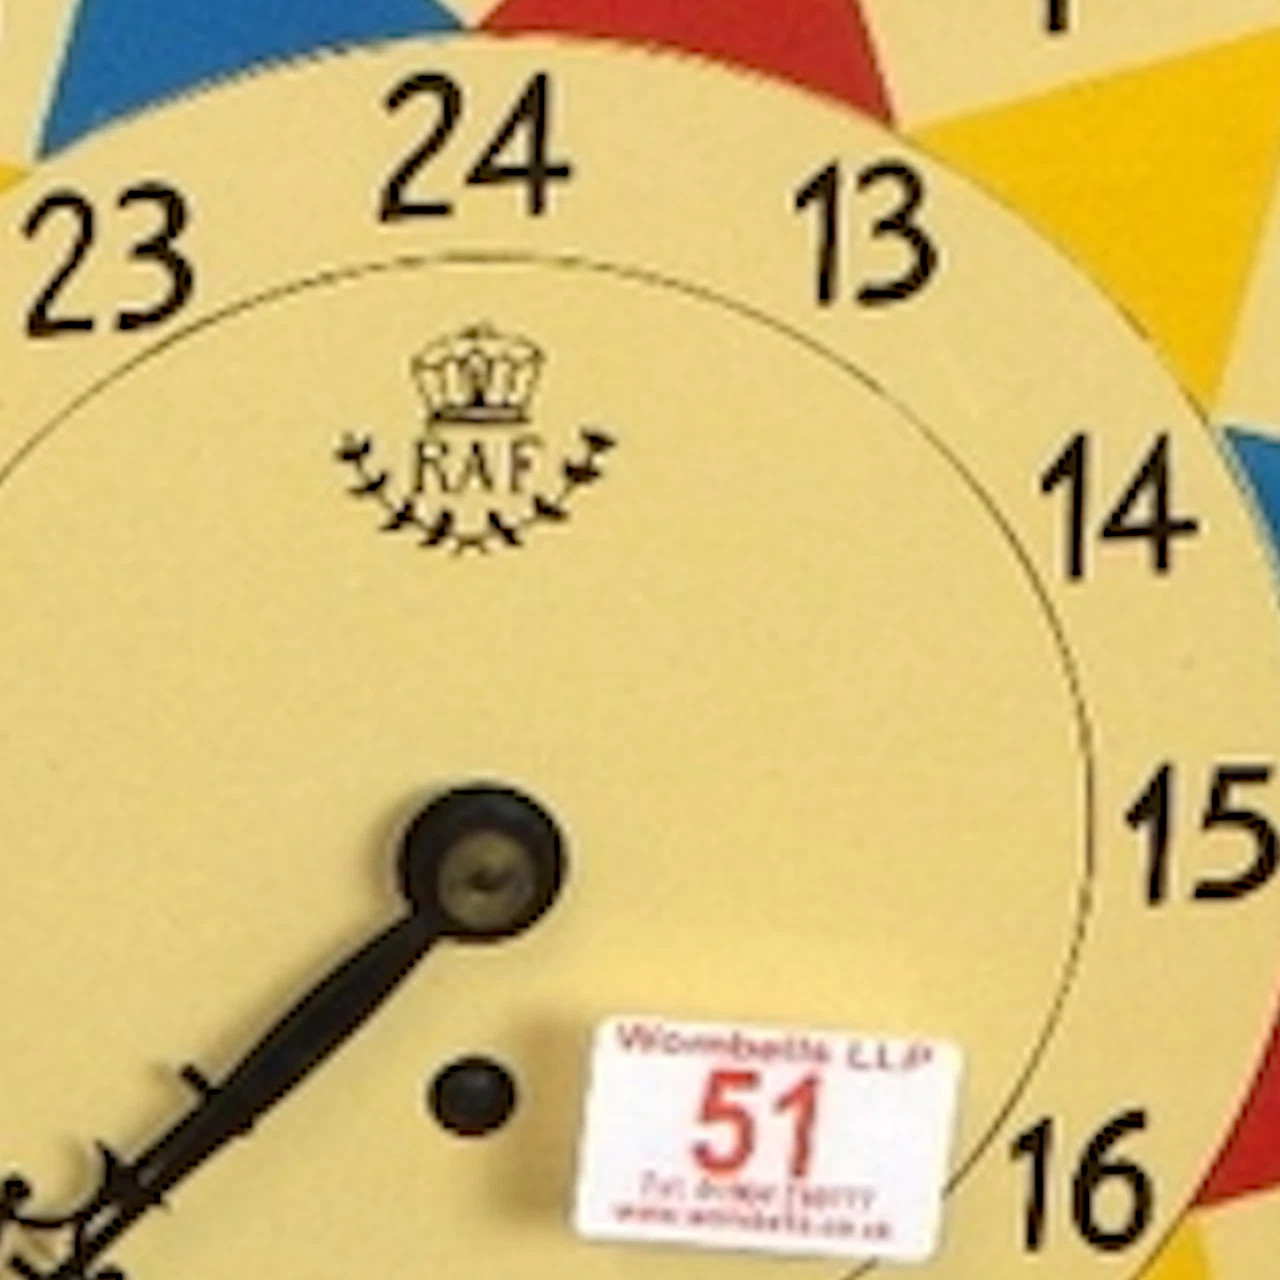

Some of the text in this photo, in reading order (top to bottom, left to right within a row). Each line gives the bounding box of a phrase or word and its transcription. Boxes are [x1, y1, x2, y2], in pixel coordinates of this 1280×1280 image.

[378, 71, 573, 221] 24
[22, 180, 195, 339] 23
[794, 159, 938, 308] 13
[413, 434, 544, 494] RAF
[1040, 432, 1200, 578] 14
[691, 1069, 822, 1179] 51
[846, 1038, 934, 1072] LLP
[1010, 1108, 1154, 1254] 16
